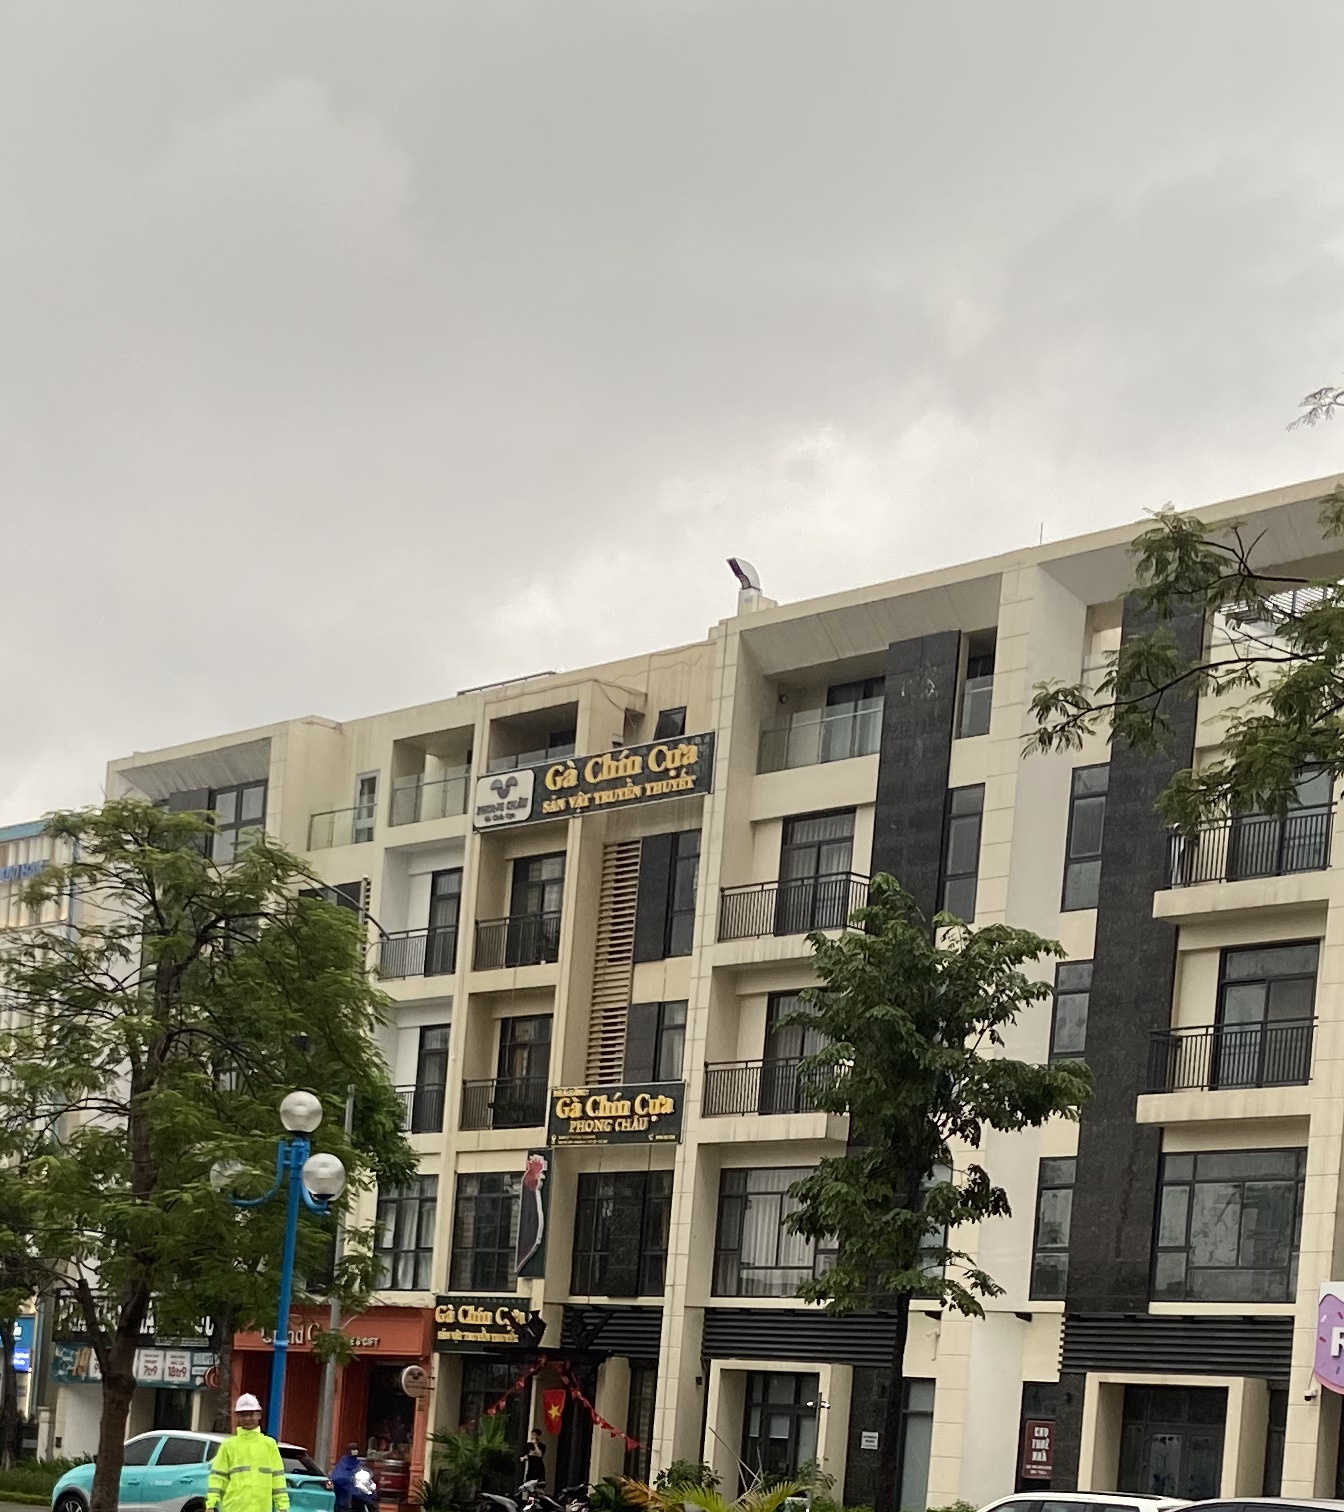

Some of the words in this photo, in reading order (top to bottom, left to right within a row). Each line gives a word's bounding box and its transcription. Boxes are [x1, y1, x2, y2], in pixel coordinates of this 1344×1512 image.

[545, 759, 579, 791] Gà
[584, 749, 643, 784] Chín
[647, 743, 699, 777] Cựa
[555, 1096, 583, 1119] Gà
[586, 1091, 632, 1117] Chín
[634, 1093, 675, 1122] Cựa
[569, 1119, 613, 1133] PHONG
